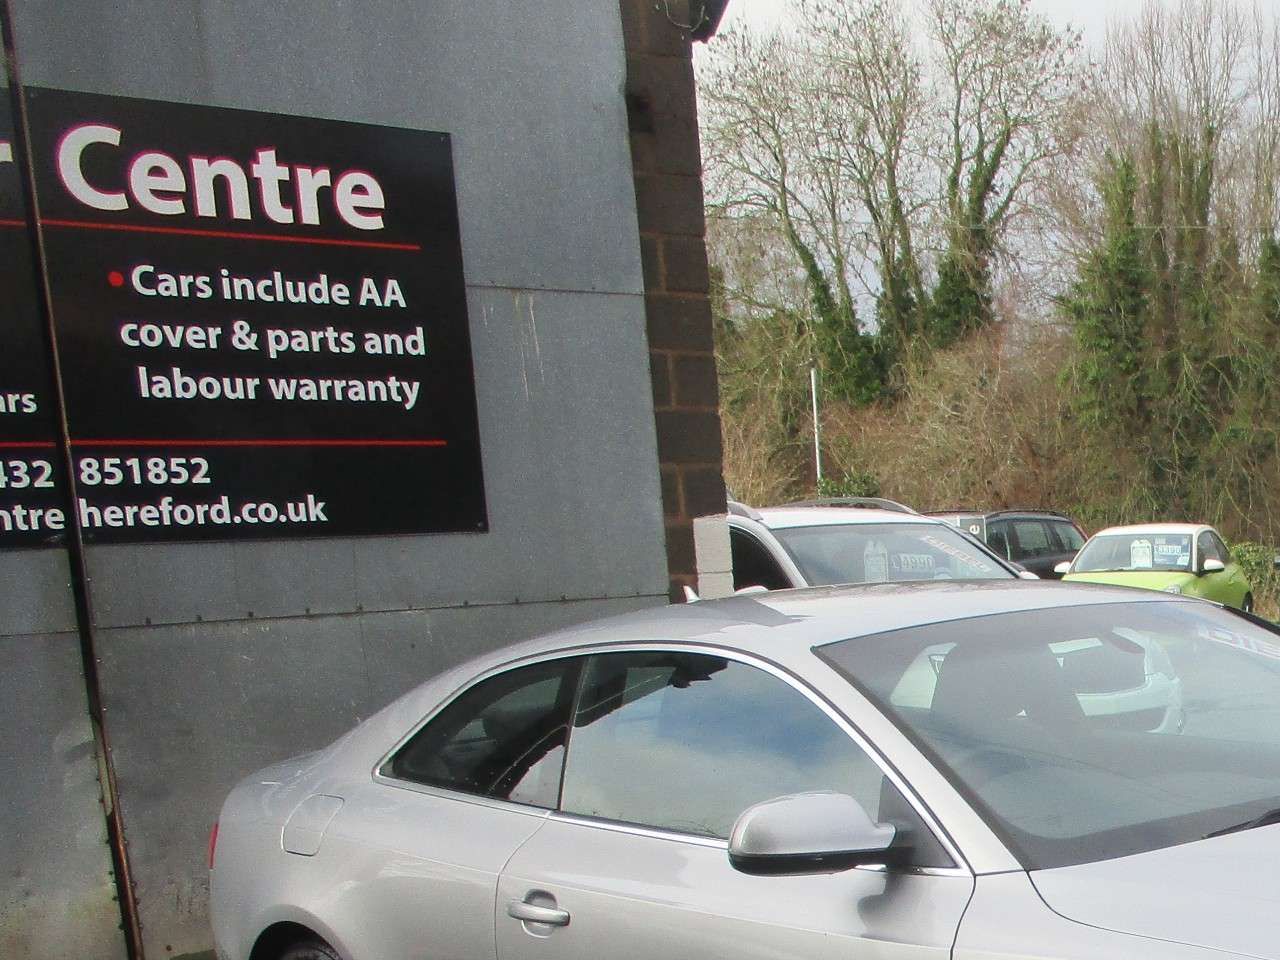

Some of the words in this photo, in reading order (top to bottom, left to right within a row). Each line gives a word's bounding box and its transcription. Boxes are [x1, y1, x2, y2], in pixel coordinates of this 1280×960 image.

[58, 125, 385, 230] Centre
[131, 264, 213, 299] Cars
[220, 268, 350, 306] include
[358, 277, 407, 308] AA
[120, 323, 222, 349] cover
[231, 320, 259, 351] &
[266, 326, 356, 359] parts
[364, 326, 426, 356] and
[137, 366, 260, 400] labour
[267, 375, 420, 410] warranty
[79, 457, 211, 486] 851852
[78, 495, 329, 528] hereford.co.uk
